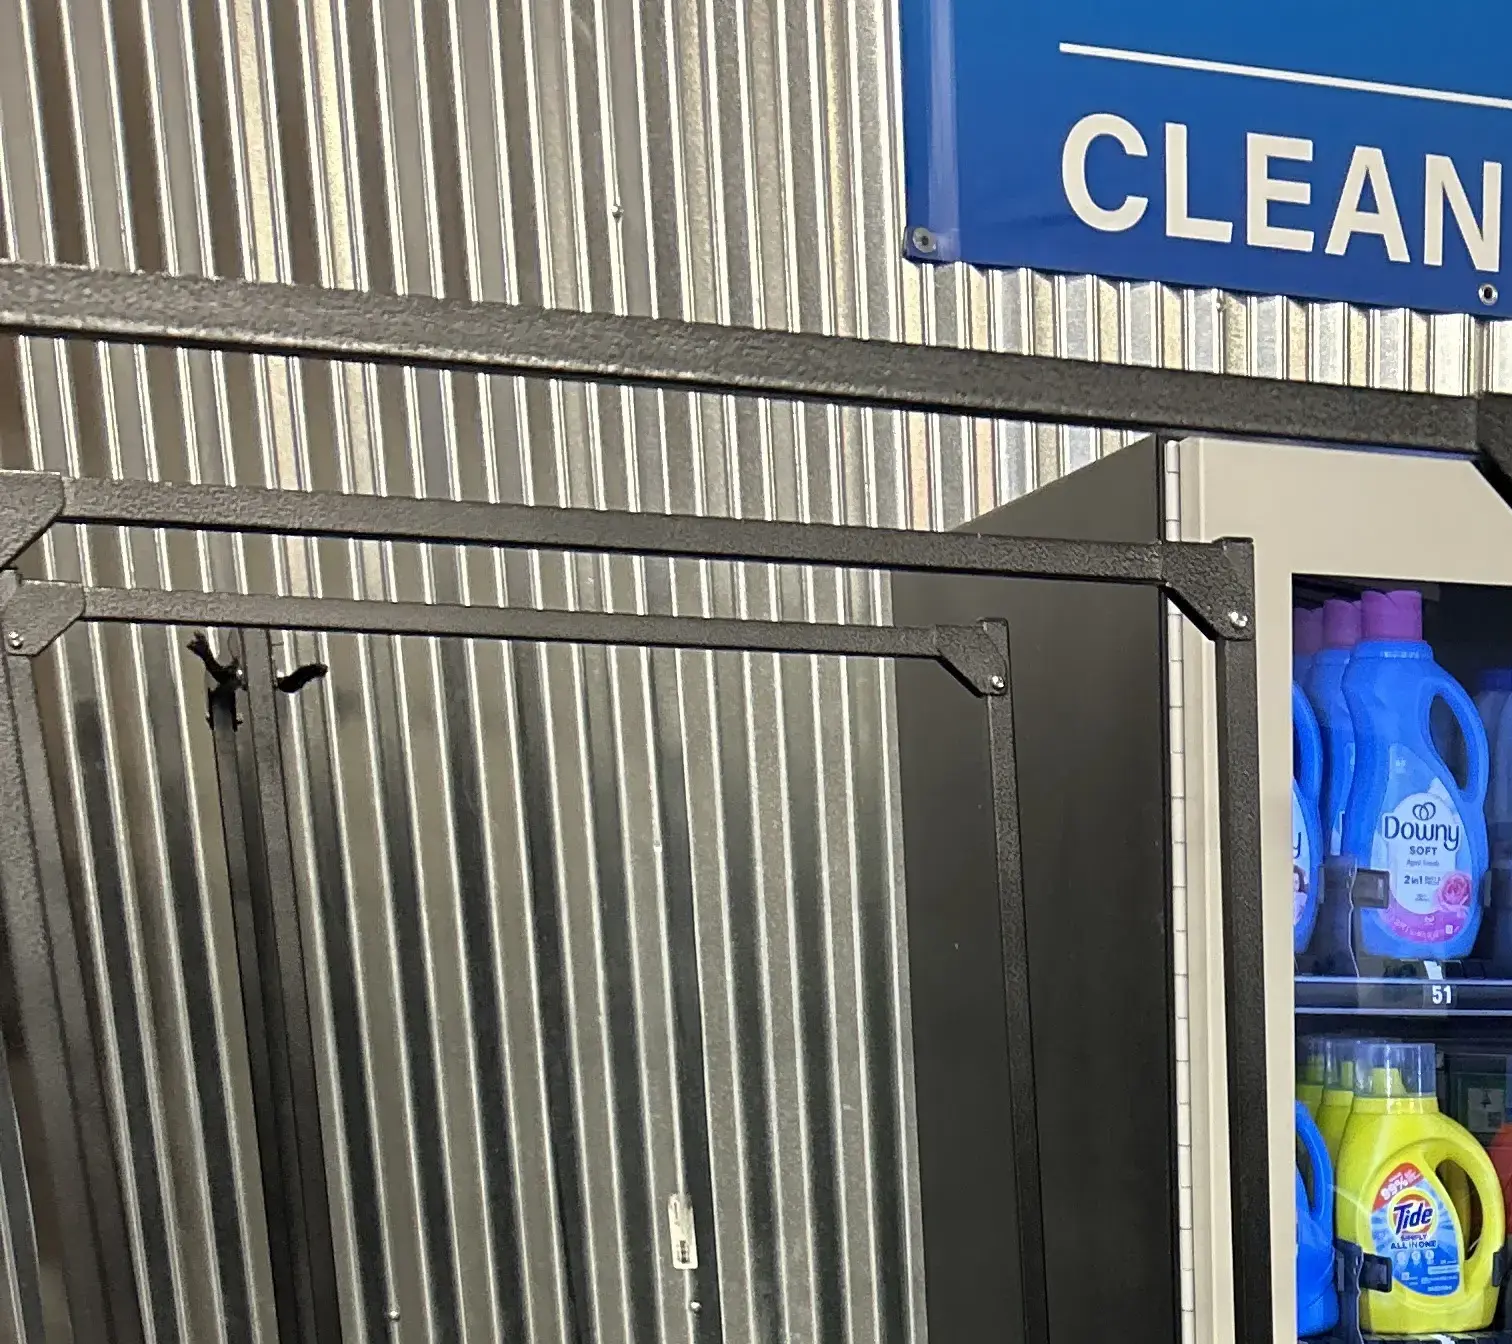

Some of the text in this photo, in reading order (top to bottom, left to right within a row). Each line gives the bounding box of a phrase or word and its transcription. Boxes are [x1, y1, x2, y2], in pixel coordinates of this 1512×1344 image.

[1384, 815, 1460, 851] Downy
[1409, 846, 1438, 856] SOFT
[1432, 985, 1452, 1004] 51
[1393, 1202, 1433, 1234] Tide
